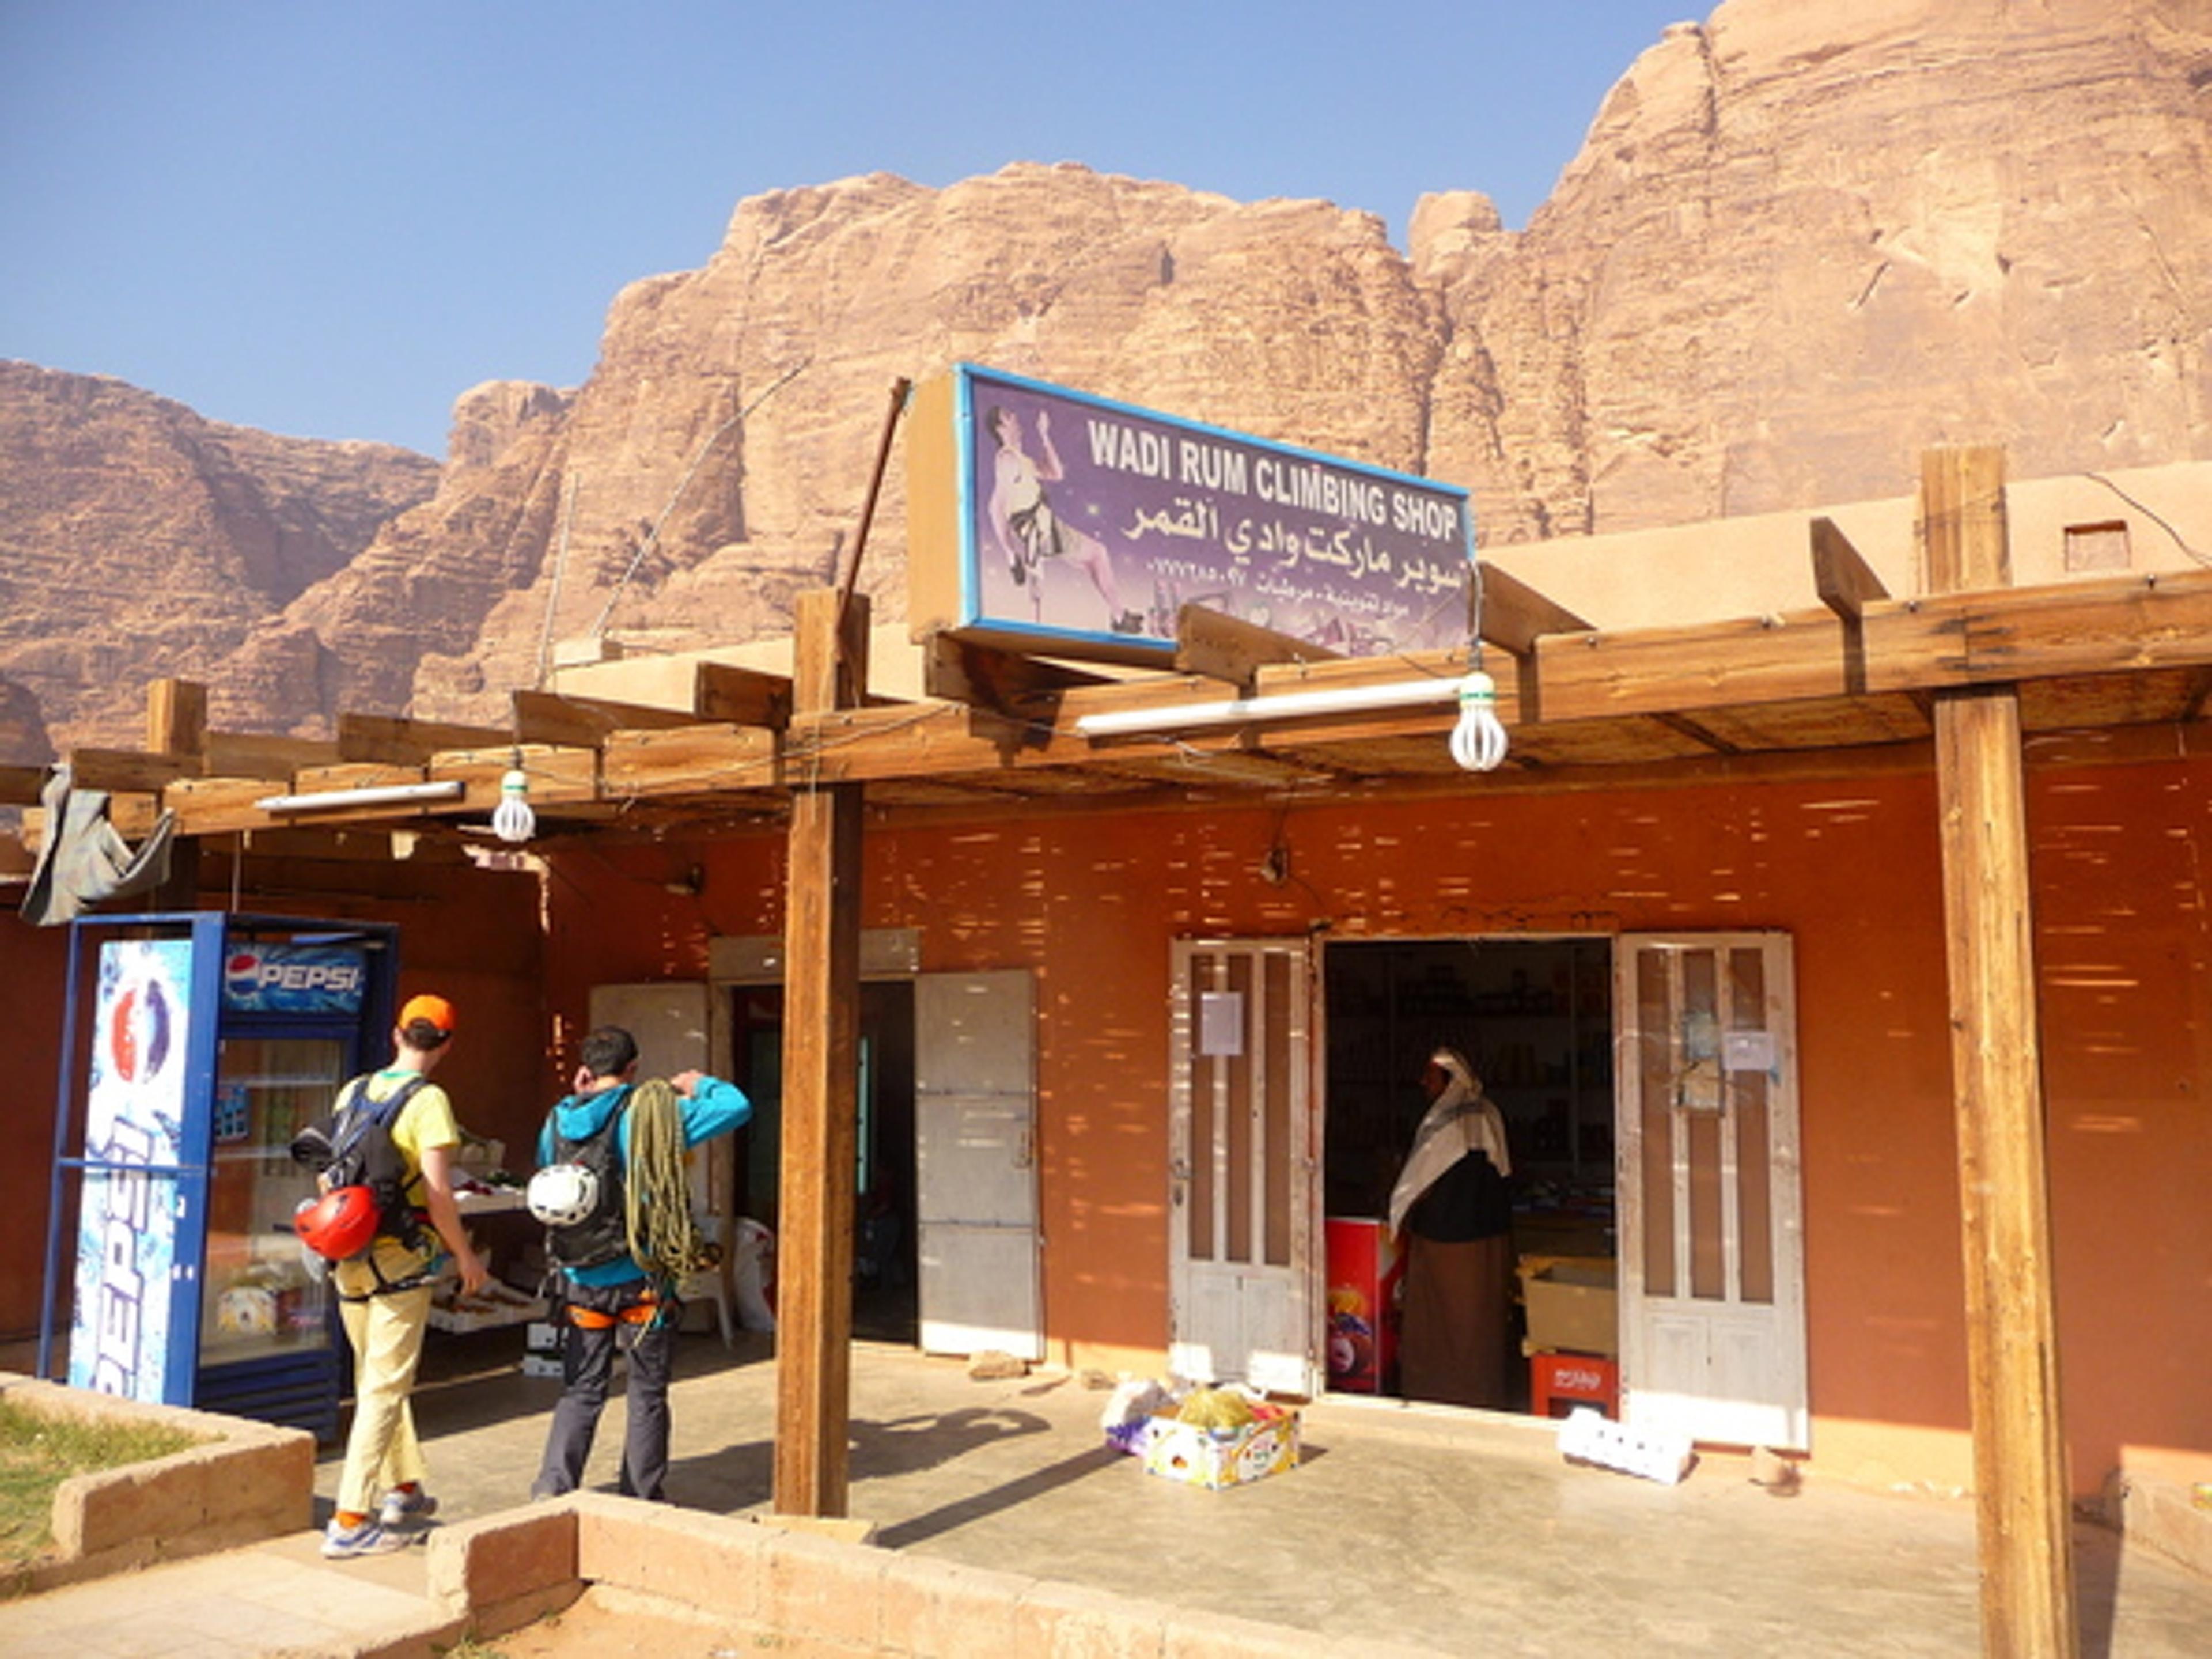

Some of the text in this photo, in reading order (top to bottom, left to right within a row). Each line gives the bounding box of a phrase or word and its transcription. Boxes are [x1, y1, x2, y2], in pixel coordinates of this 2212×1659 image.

[1088, 420, 1457, 540] WADI RUM CLIMBING SHOP
[1121, 497, 1218, 540] القمر
[1225, 518, 1299, 567] وادي
[1305, 527, 1391, 579] ماركت
[259, 964, 359, 990] PEPSI
